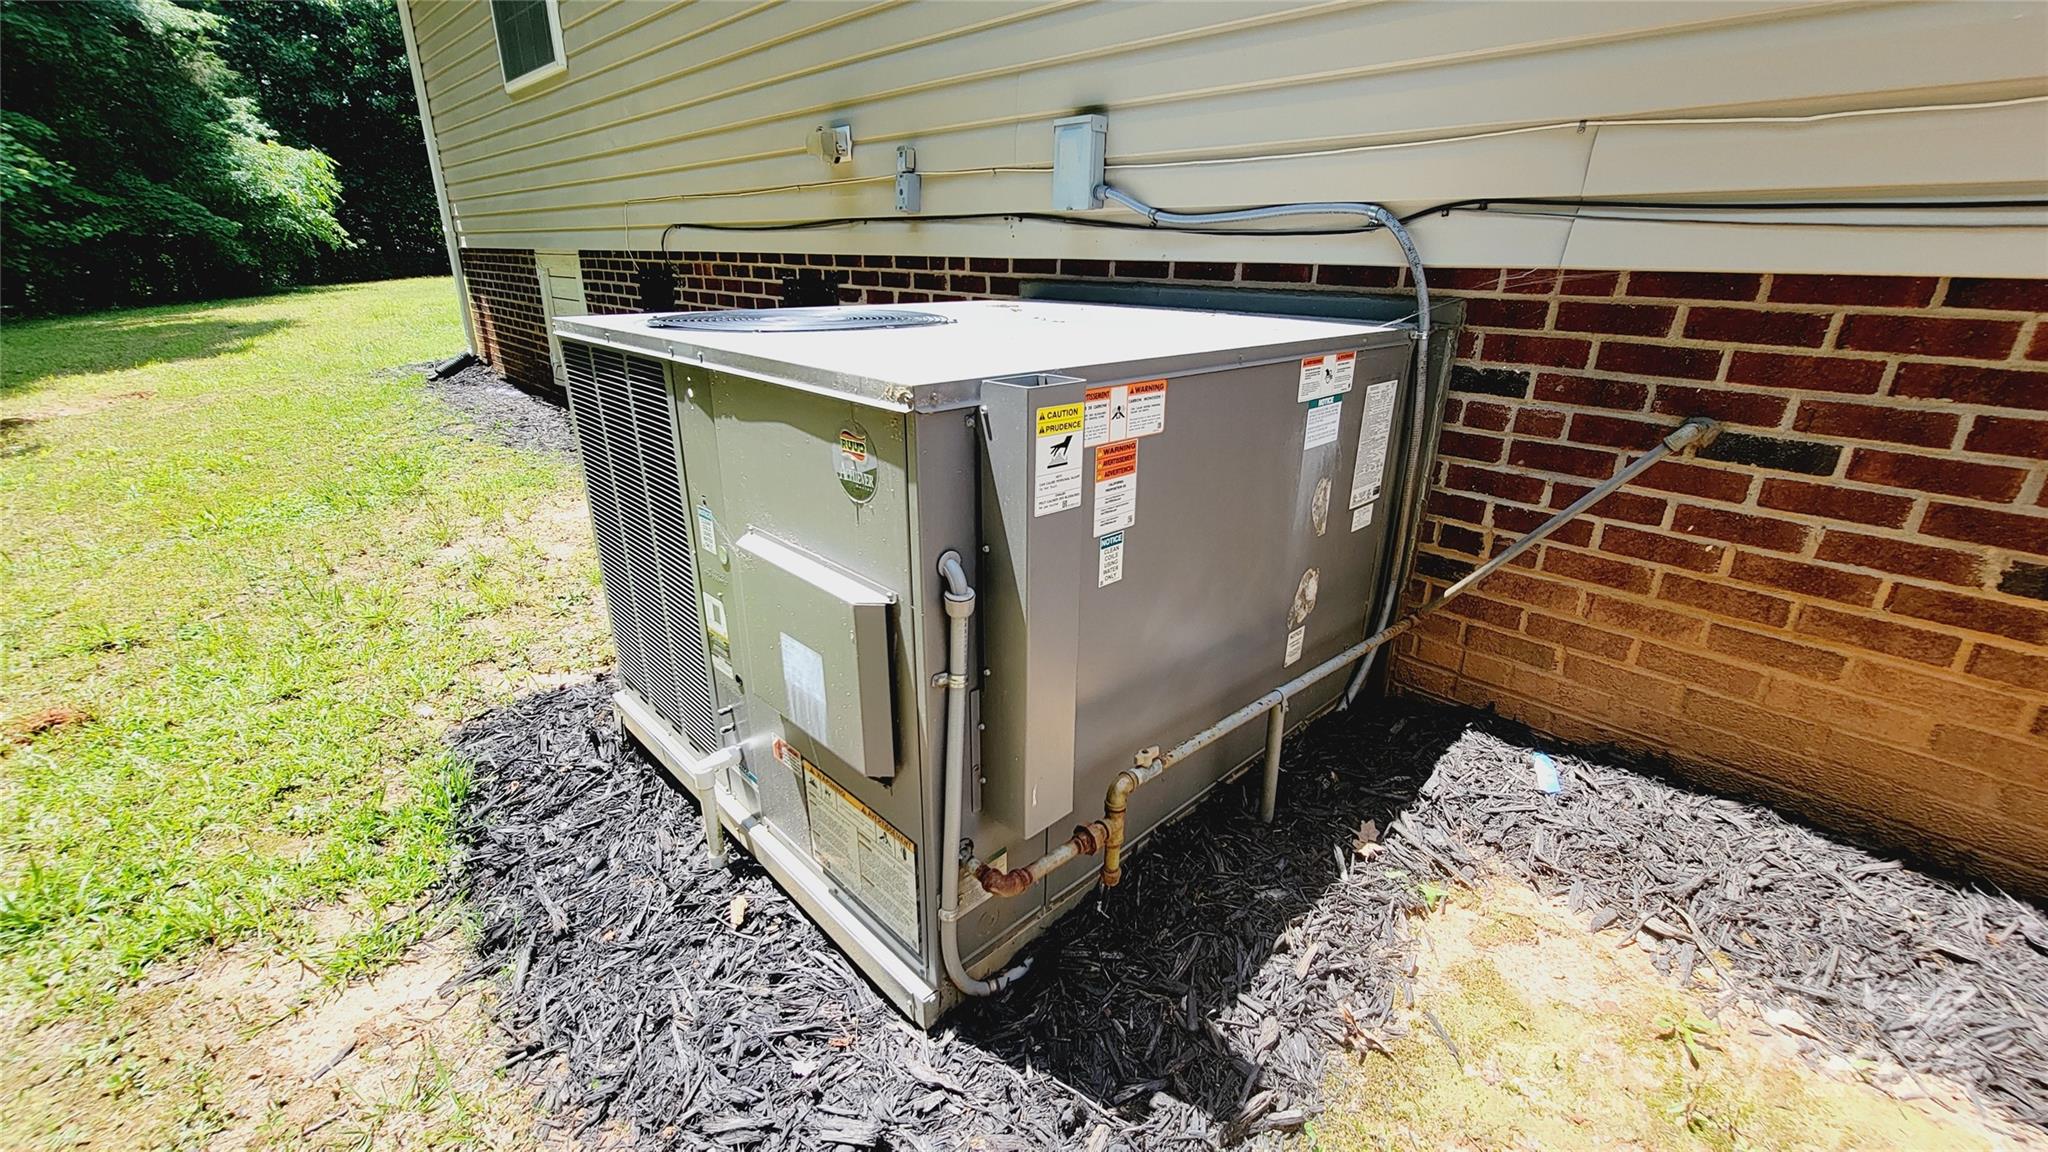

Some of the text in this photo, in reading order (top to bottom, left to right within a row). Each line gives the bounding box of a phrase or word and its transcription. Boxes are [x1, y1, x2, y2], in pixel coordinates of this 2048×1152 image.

[1135, 383, 1164, 394] WARNING
[1046, 408, 1079, 420] CAUTION
[1045, 420, 1081, 433] PRUDENCE
[841, 438, 865, 454] RUUD
[1103, 442, 1136, 456] WARNING
[1104, 465, 1134, 478] ADVERTENCIA
[1101, 534, 1123, 547] NOTICE
[1104, 545, 1120, 555] CLEAN
[1104, 552, 1119, 562] COILS
[1103, 559, 1119, 569] USING
[1103, 565, 1119, 575] WATER
[1104, 572, 1117, 581] ONLY
